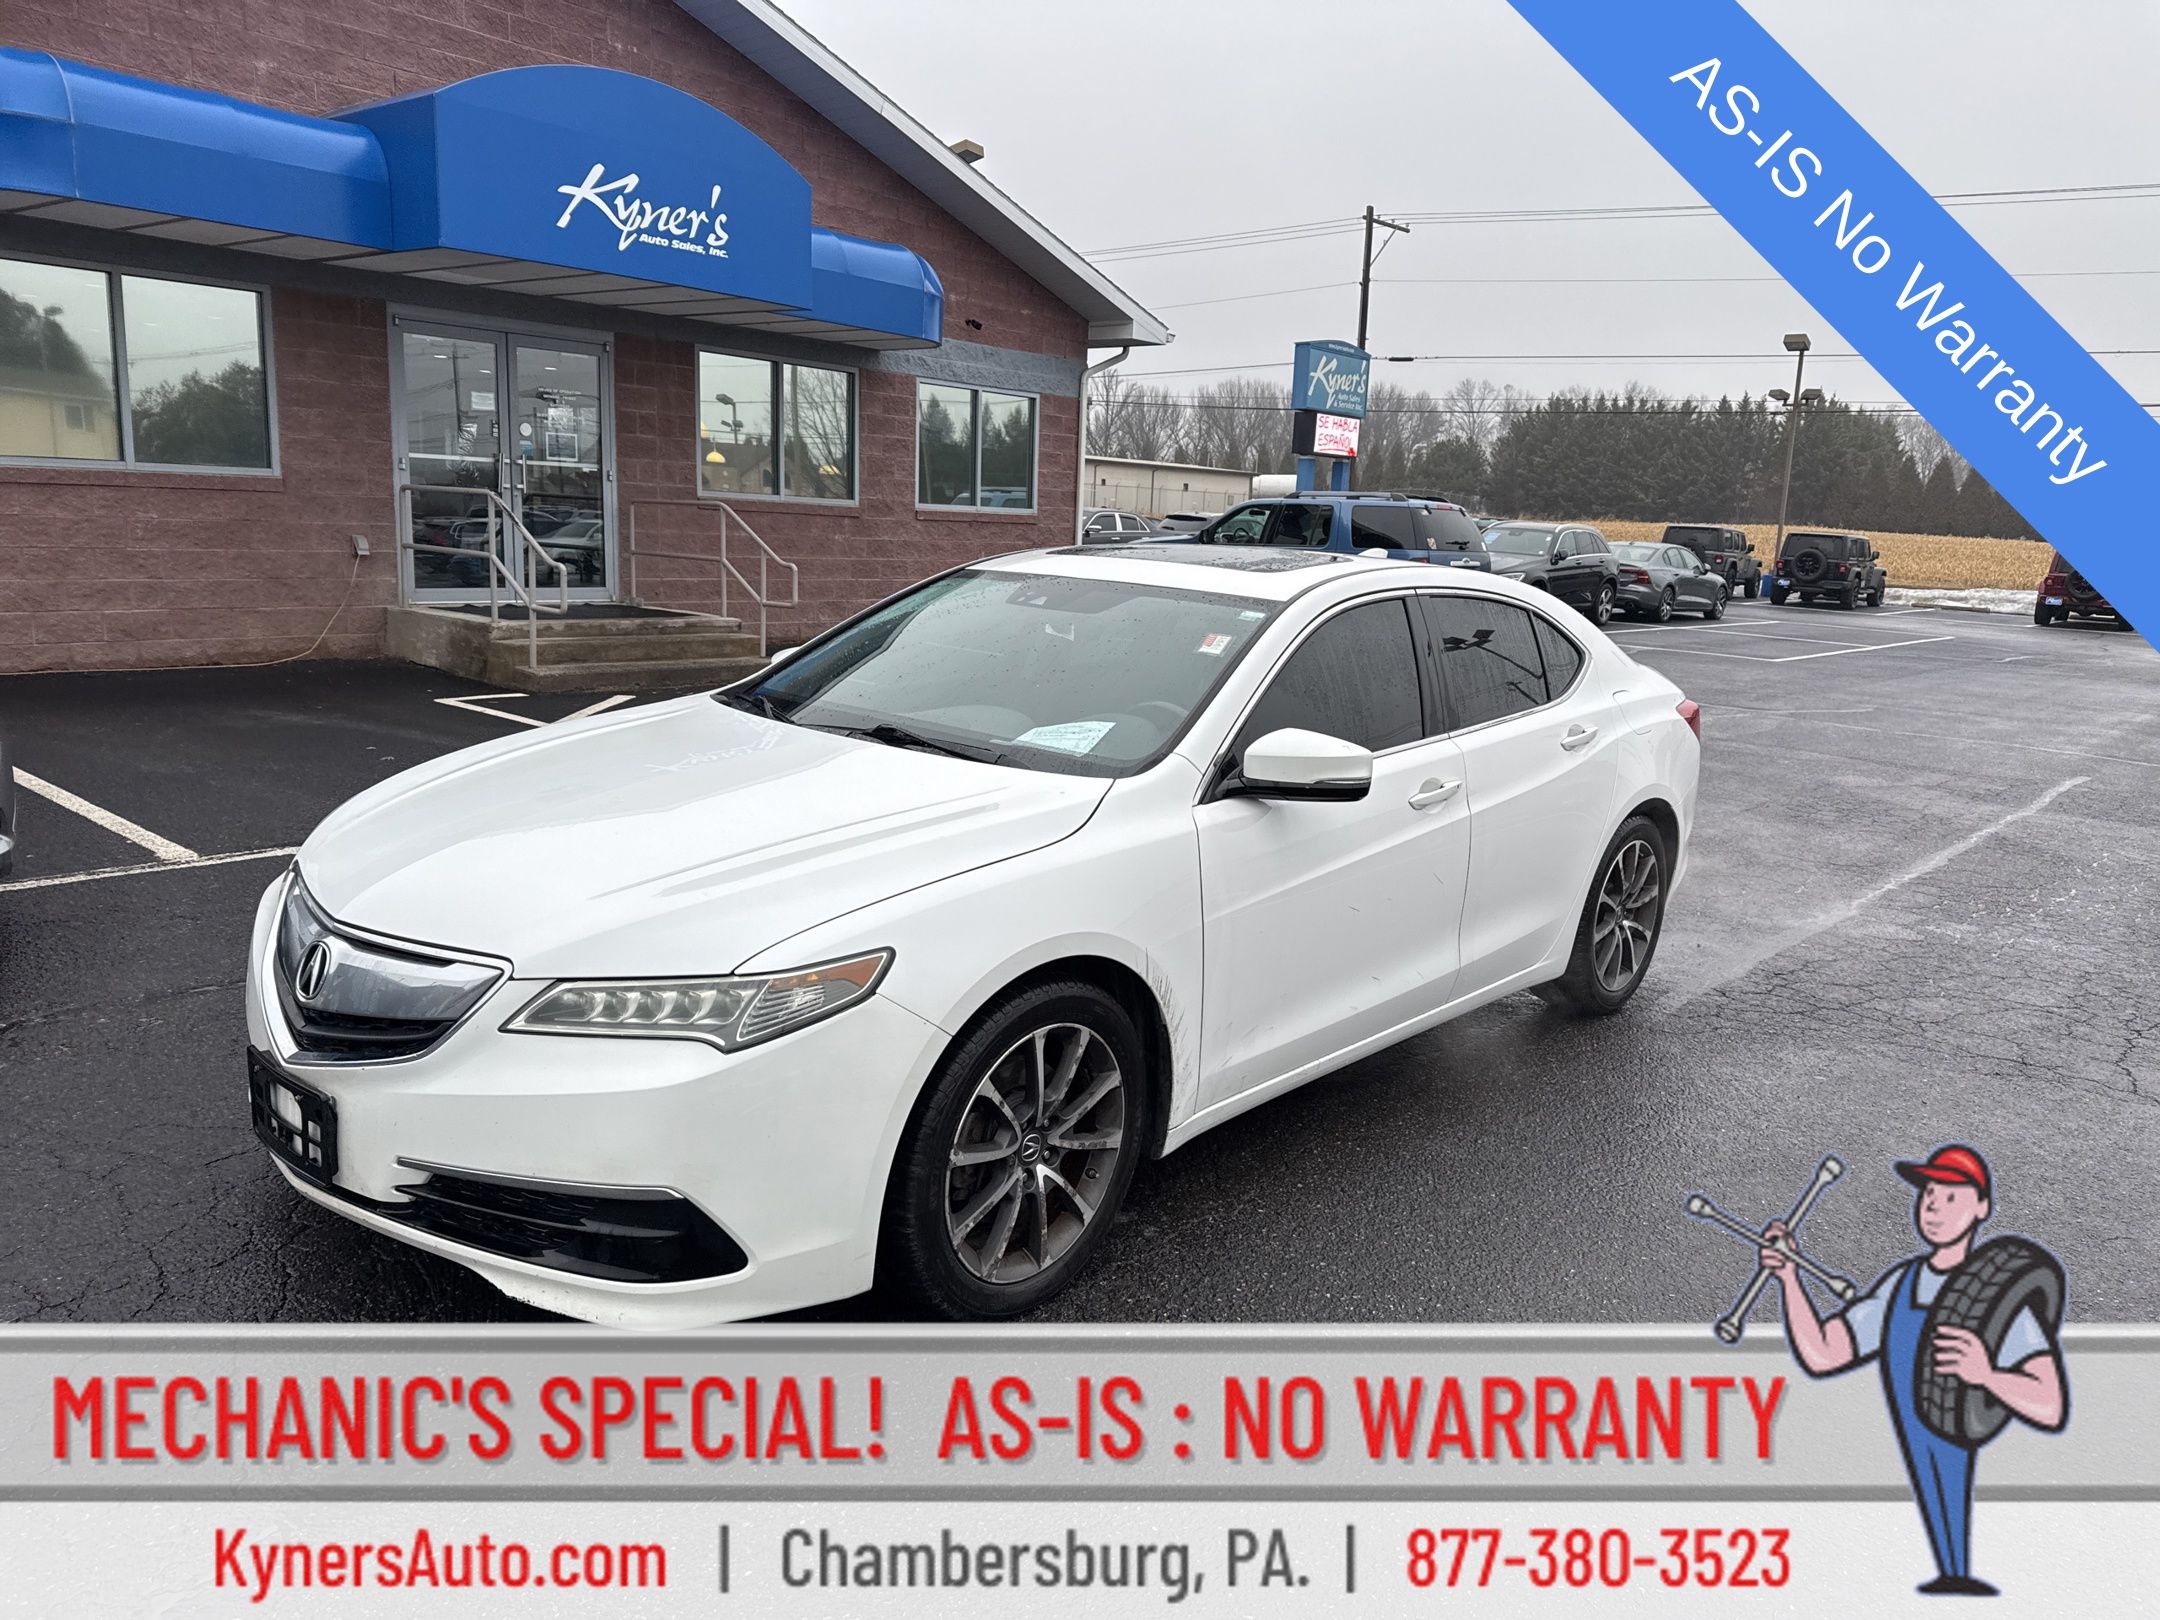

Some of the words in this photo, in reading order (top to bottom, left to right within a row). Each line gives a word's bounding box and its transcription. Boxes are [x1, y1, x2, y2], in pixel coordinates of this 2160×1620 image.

[556, 163, 729, 252] Kyner's
[639, 233, 669, 247] Auto
[671, 239, 706, 255] Sales,
[708, 246, 729, 259] Inc.
[1308, 355, 1367, 409] Kyner's
[1318, 415, 1330, 429] SE
[1332, 417, 1358, 433] HABLA
